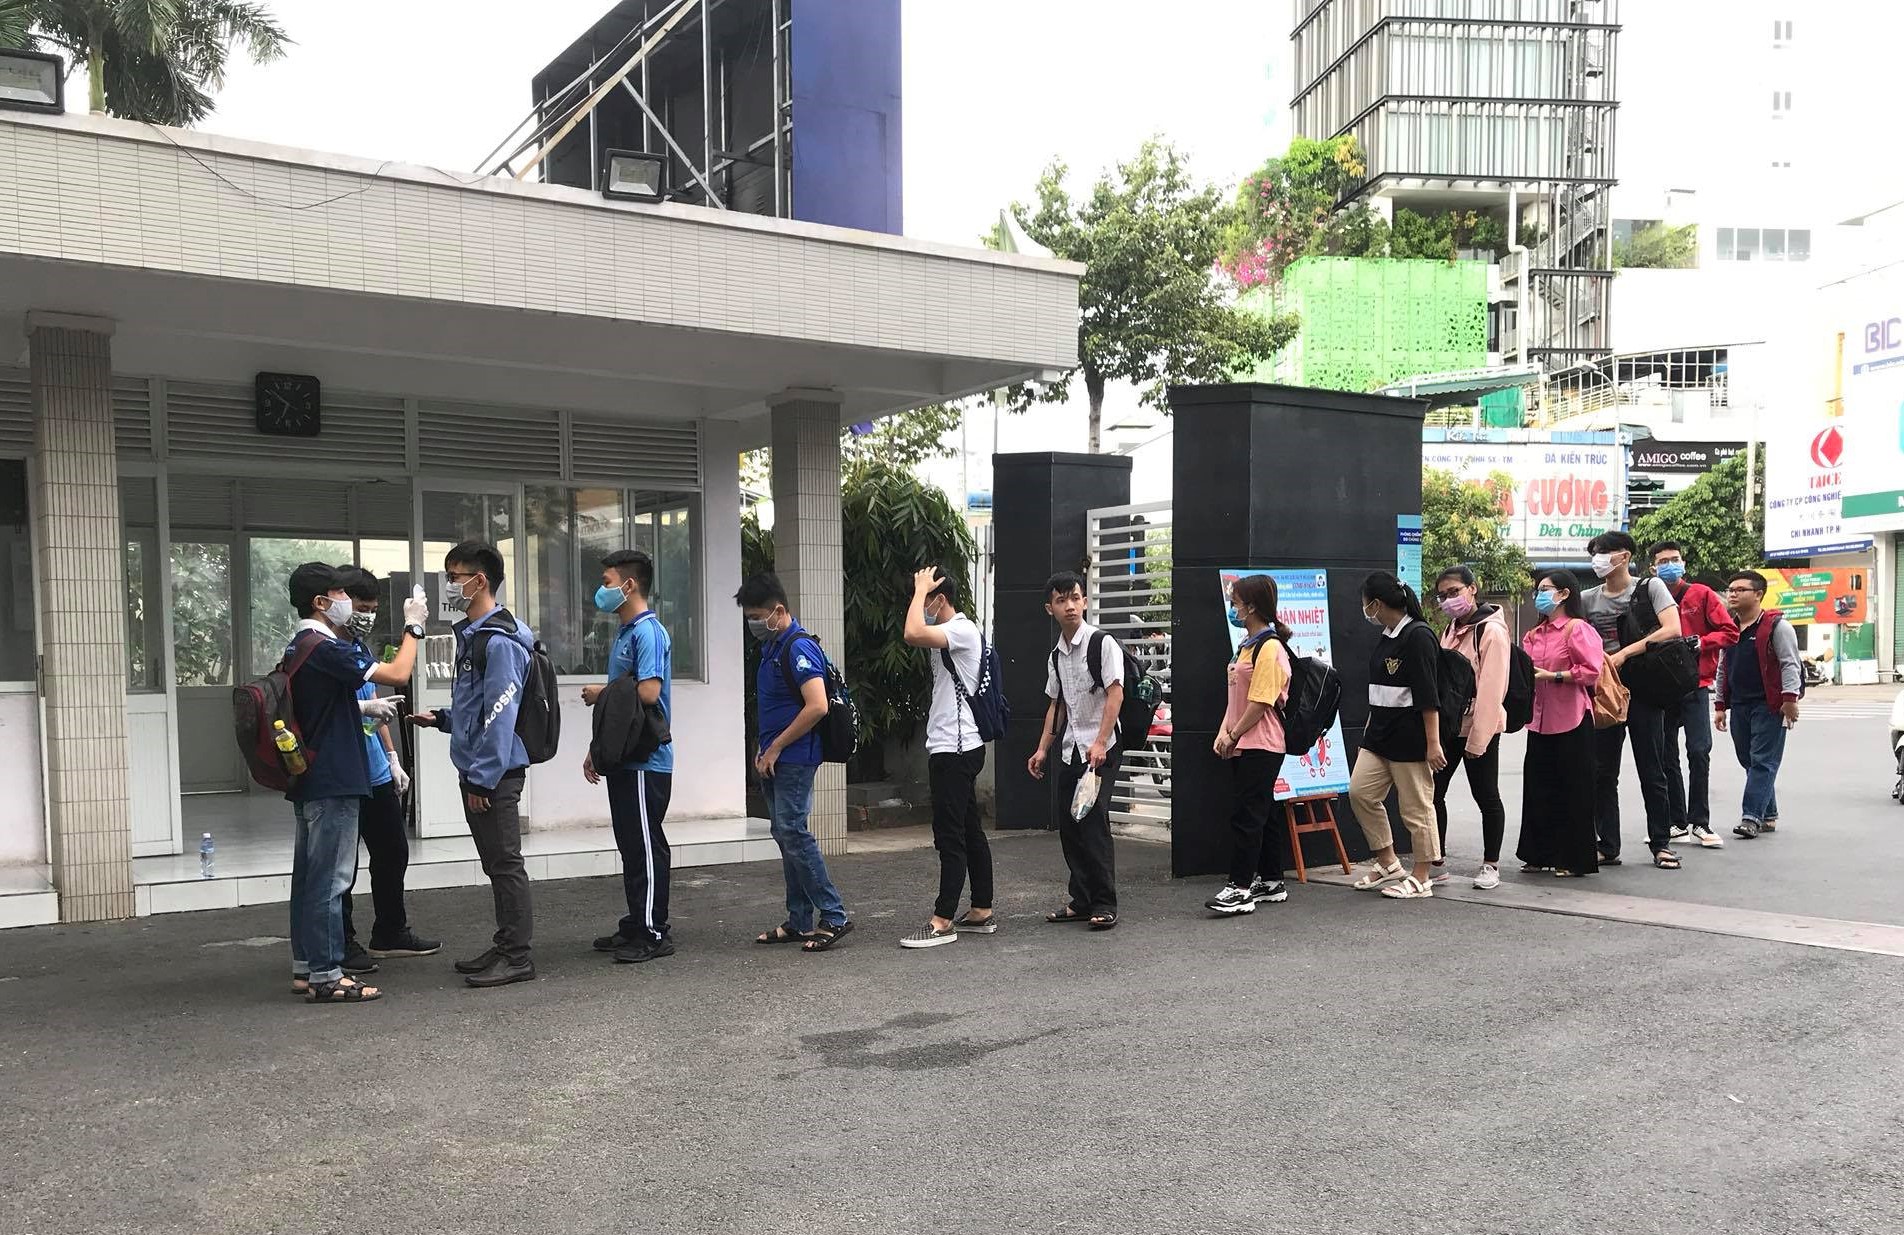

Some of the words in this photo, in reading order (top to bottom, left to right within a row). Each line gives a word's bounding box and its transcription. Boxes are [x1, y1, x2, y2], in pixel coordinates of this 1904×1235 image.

[1637, 452, 1678, 464] AMIGO
[1680, 451, 1707, 461] coffee
[1526, 473, 1609, 517] CƯƠNG
[1538, 522, 1563, 537] Đèn
[1297, 606, 1325, 629] NHIỆT
